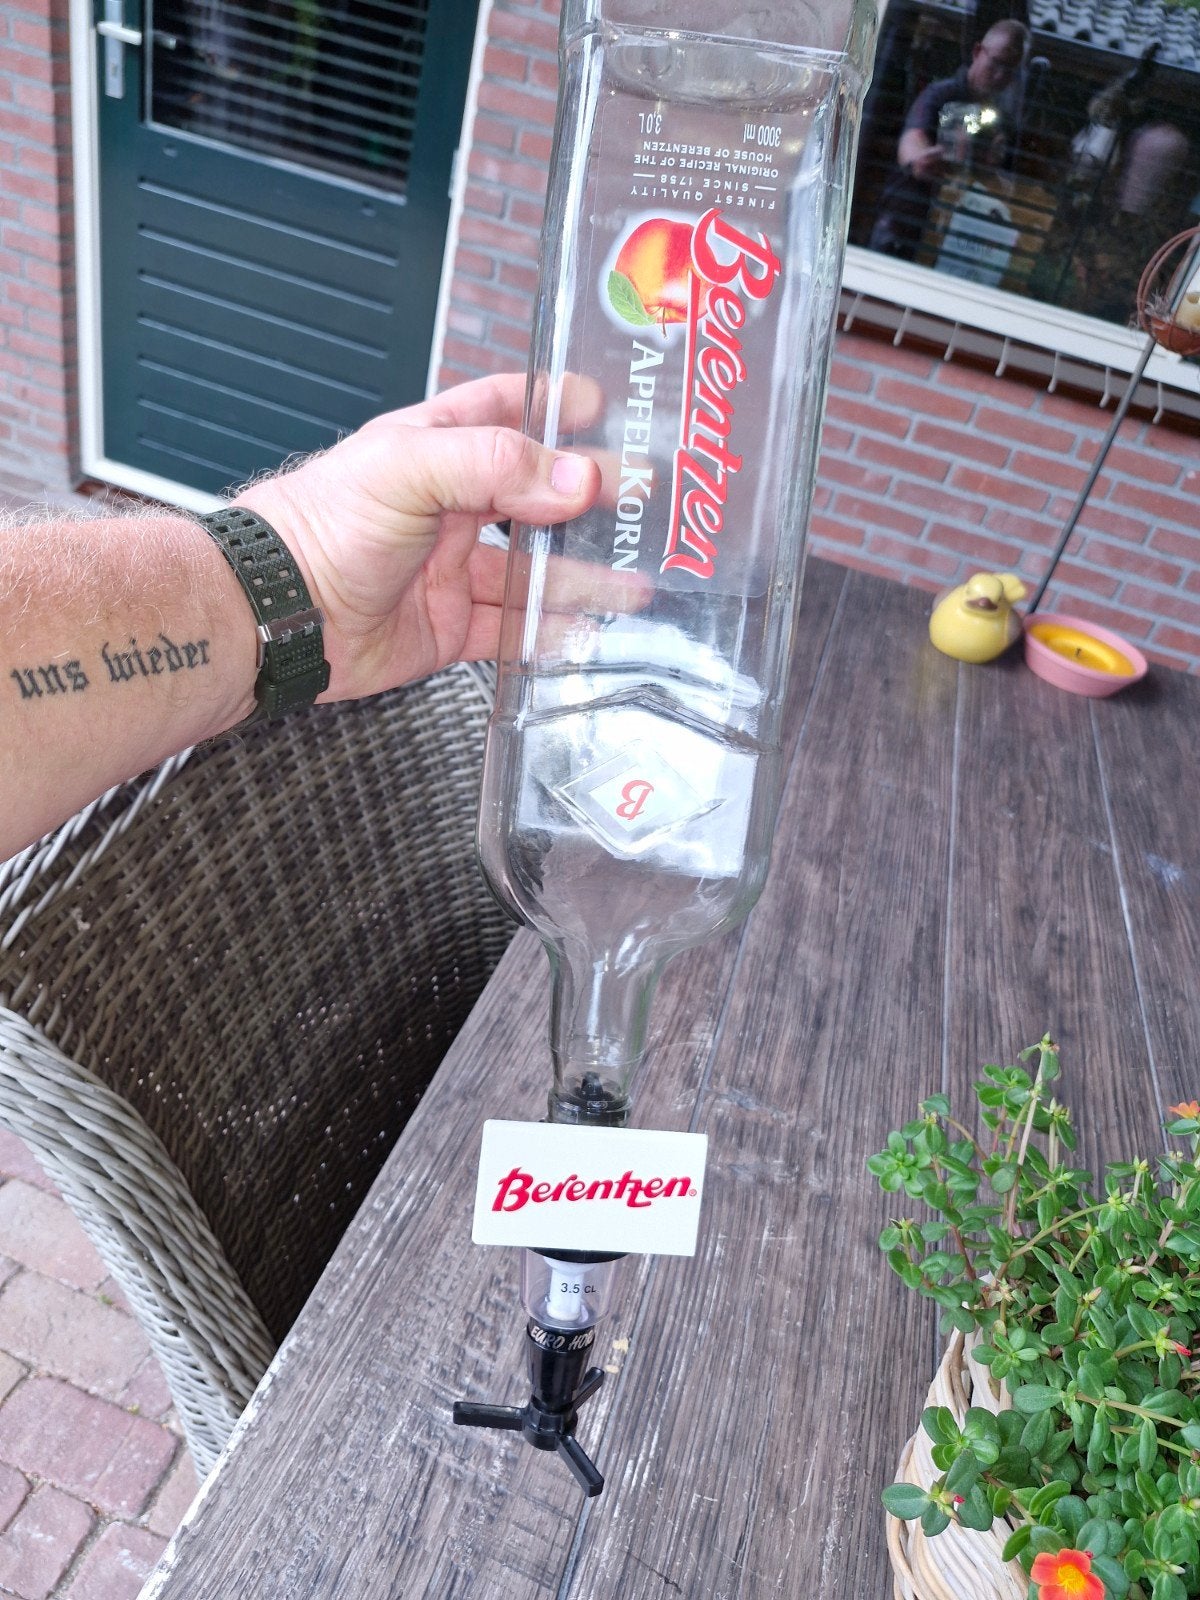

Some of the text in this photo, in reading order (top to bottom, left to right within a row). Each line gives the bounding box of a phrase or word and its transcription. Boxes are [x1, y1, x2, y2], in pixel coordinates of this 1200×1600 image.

[646, 111, 663, 135] 3,0
[743, 122, 782, 147] 3000 ml
[643, 141, 772, 163] HOUSE OF BERENTZEN
[634, 154, 779, 178] ORIGINAL RECIPE OF THE
[660, 174, 749, 192] SINCE 1758
[630, 185, 776, 210] FINEST QUALITY
[659, 207, 782, 579] Berentzen
[611, 339, 665, 574] APFELKORN
[10, 632, 211, 699] uns wieder
[615, 779, 655, 821] B
[560, 1282, 580, 1294] 3.5
[530, 1325, 566, 1349] EURO
